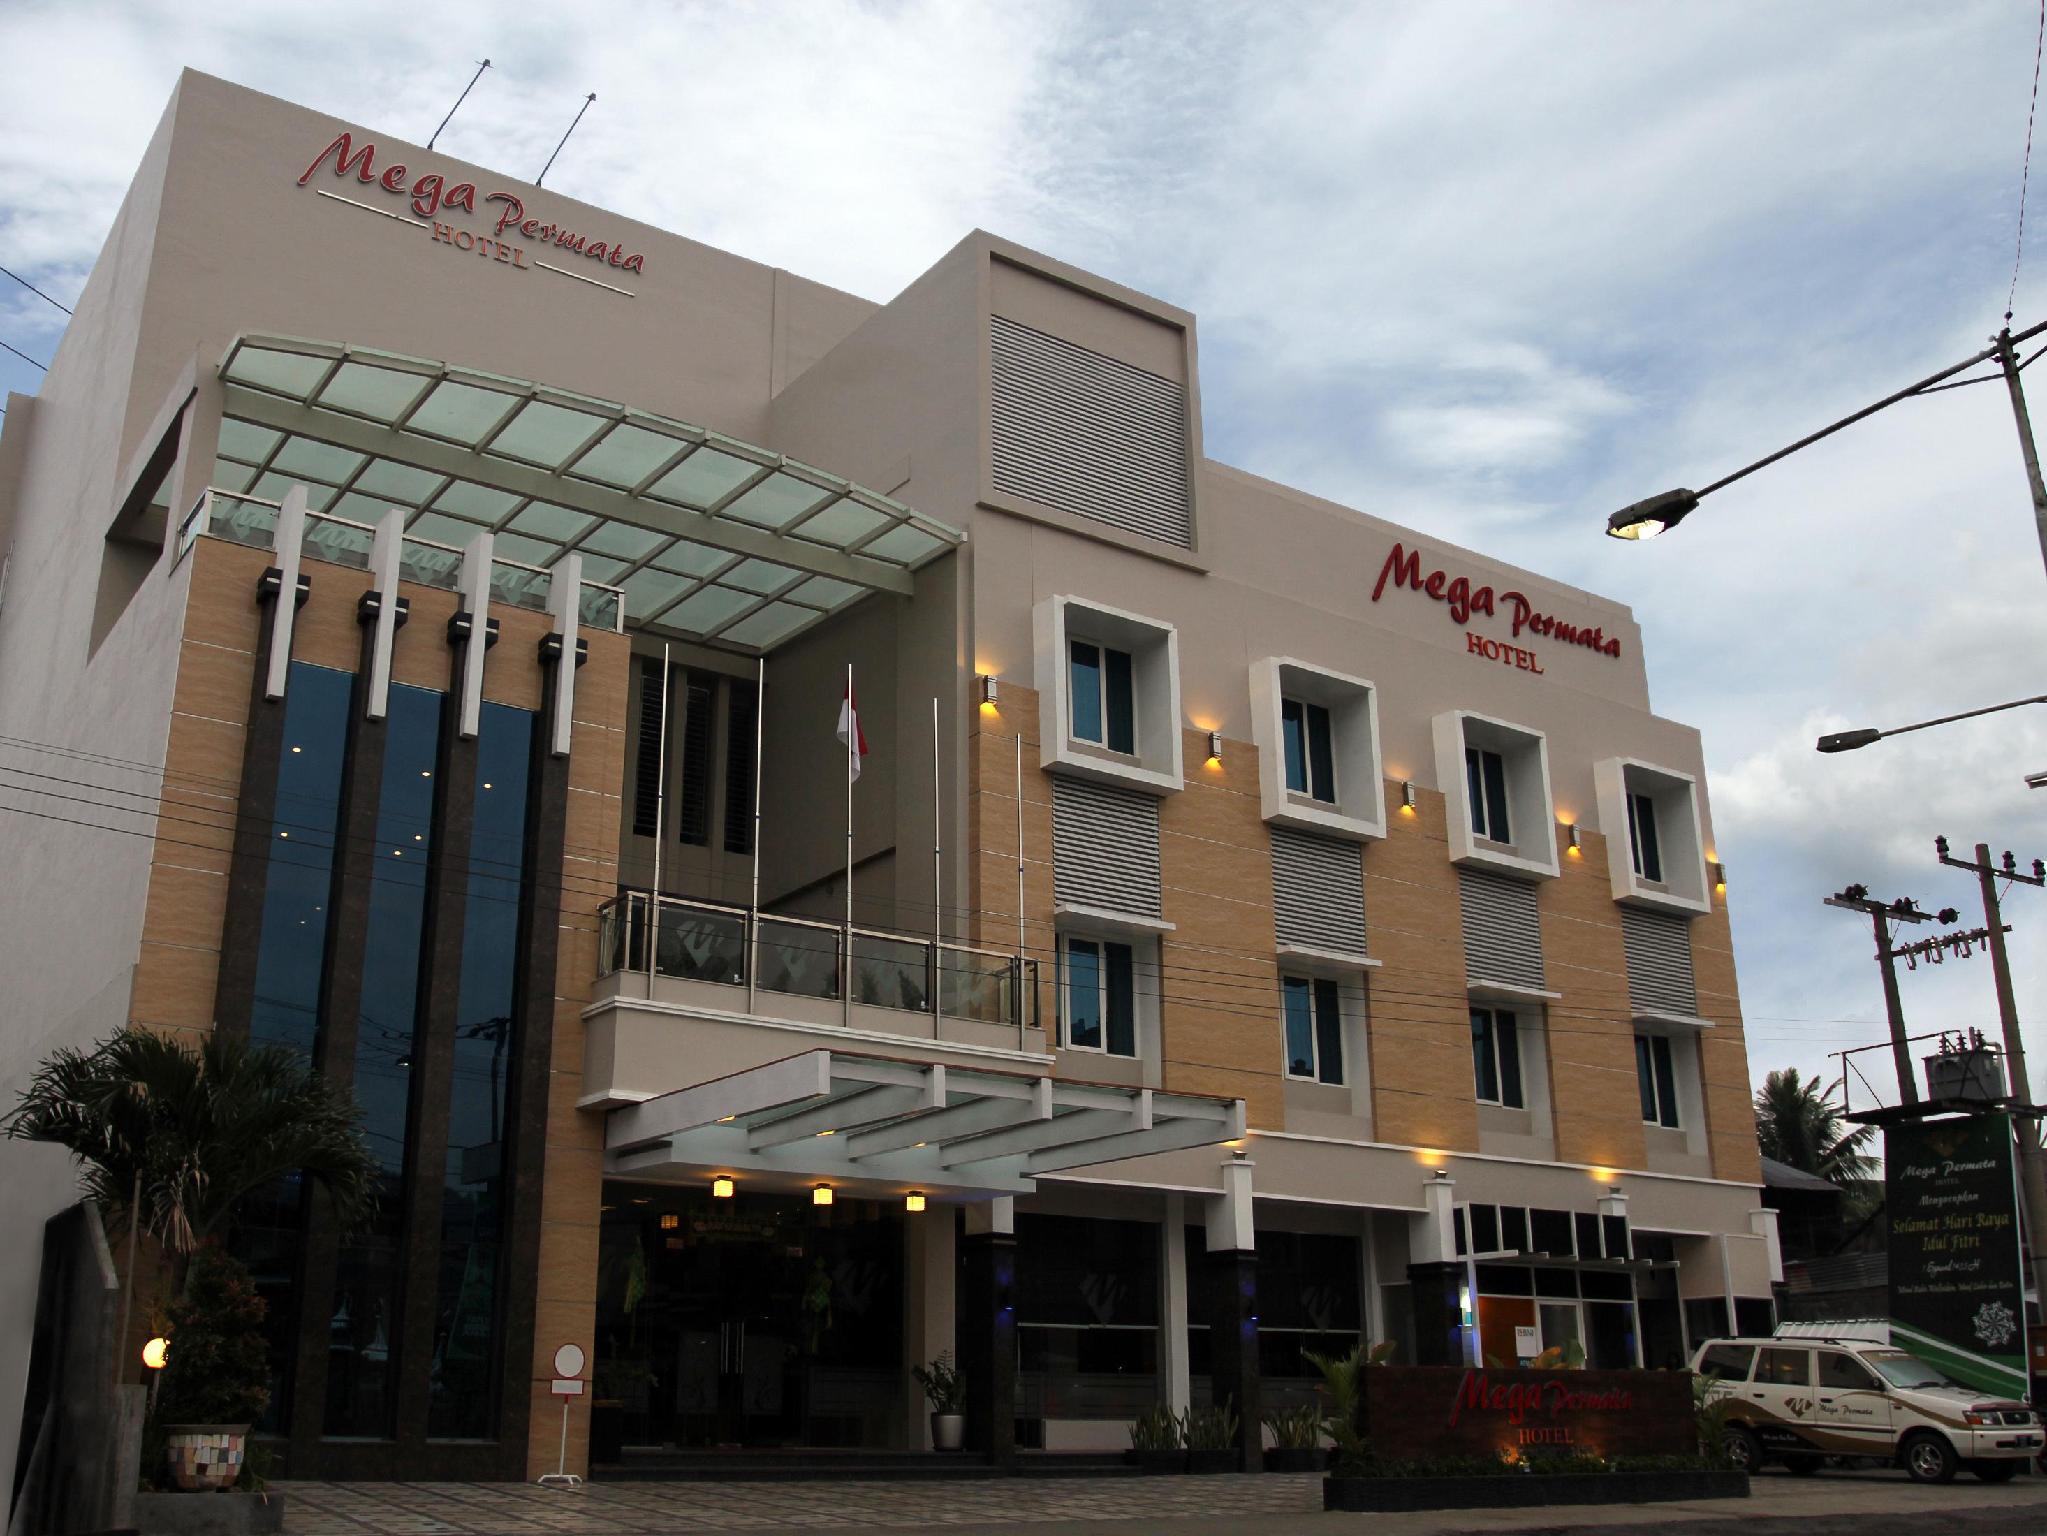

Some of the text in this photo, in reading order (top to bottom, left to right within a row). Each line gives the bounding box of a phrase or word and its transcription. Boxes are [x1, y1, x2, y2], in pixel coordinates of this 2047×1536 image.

[297, 132, 646, 274] Mega Permata
[431, 221, 529, 271] HOTEL
[1371, 542, 1621, 658] Mega Permata
[1466, 631, 1545, 675] HOTEL
[1900, 1159, 1997, 1181] Mega Permata
[1893, 1212, 2010, 1234] Selamat Hari Raya
[1922, 1234, 1980, 1253] Idul Fitri
[1450, 1369, 1633, 1429] Mega Permata
[1519, 1428, 1574, 1445] HOTEL
